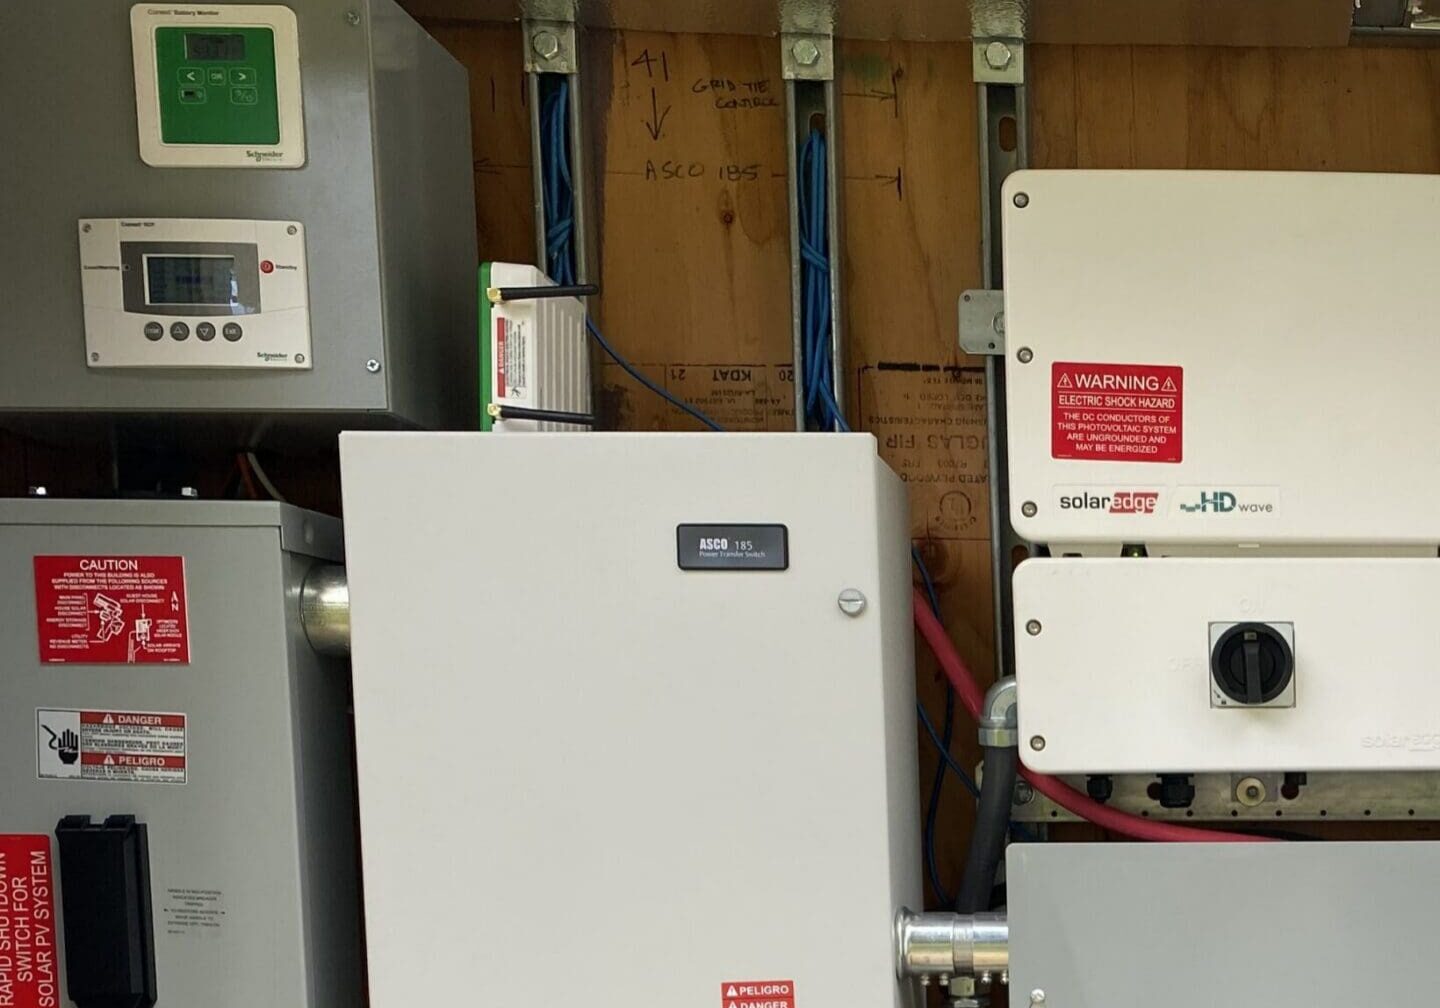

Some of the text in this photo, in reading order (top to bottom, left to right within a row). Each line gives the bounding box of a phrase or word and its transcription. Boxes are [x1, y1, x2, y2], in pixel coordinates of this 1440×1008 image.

[645, 160, 704, 181] ASCO
[712, 369, 752, 382] KDAT
[1074, 373, 1160, 391] WARNING
[1058, 394, 1176, 410] ELECTRIC SHOCK HAZARD
[1064, 412, 1170, 424] THE DC CONDUCTORS OF
[1057, 422, 1177, 434] THIS PHOTOVOLTAIC SYSTEM
[886, 434, 916, 449] FIR
[1066, 433, 1167, 444] ARE UNGROUNDED AND
[1075, 443, 1158, 454] MAY BE ENERGIZED
[1059, 491, 1160, 514] solaredge
[1238, 501, 1273, 513] wave
[699, 538, 753, 551] ASCO 185
[80, 559, 139, 571] CAUTION
[118, 715, 162, 725] DANGER
[119, 756, 166, 766] PELIGRO
[12, 876, 33, 982] SWITCH FOR
[30, 851, 55, 1007] SOLAR PV SYSTEM
[739, 985, 789, 996] PELIGRO
